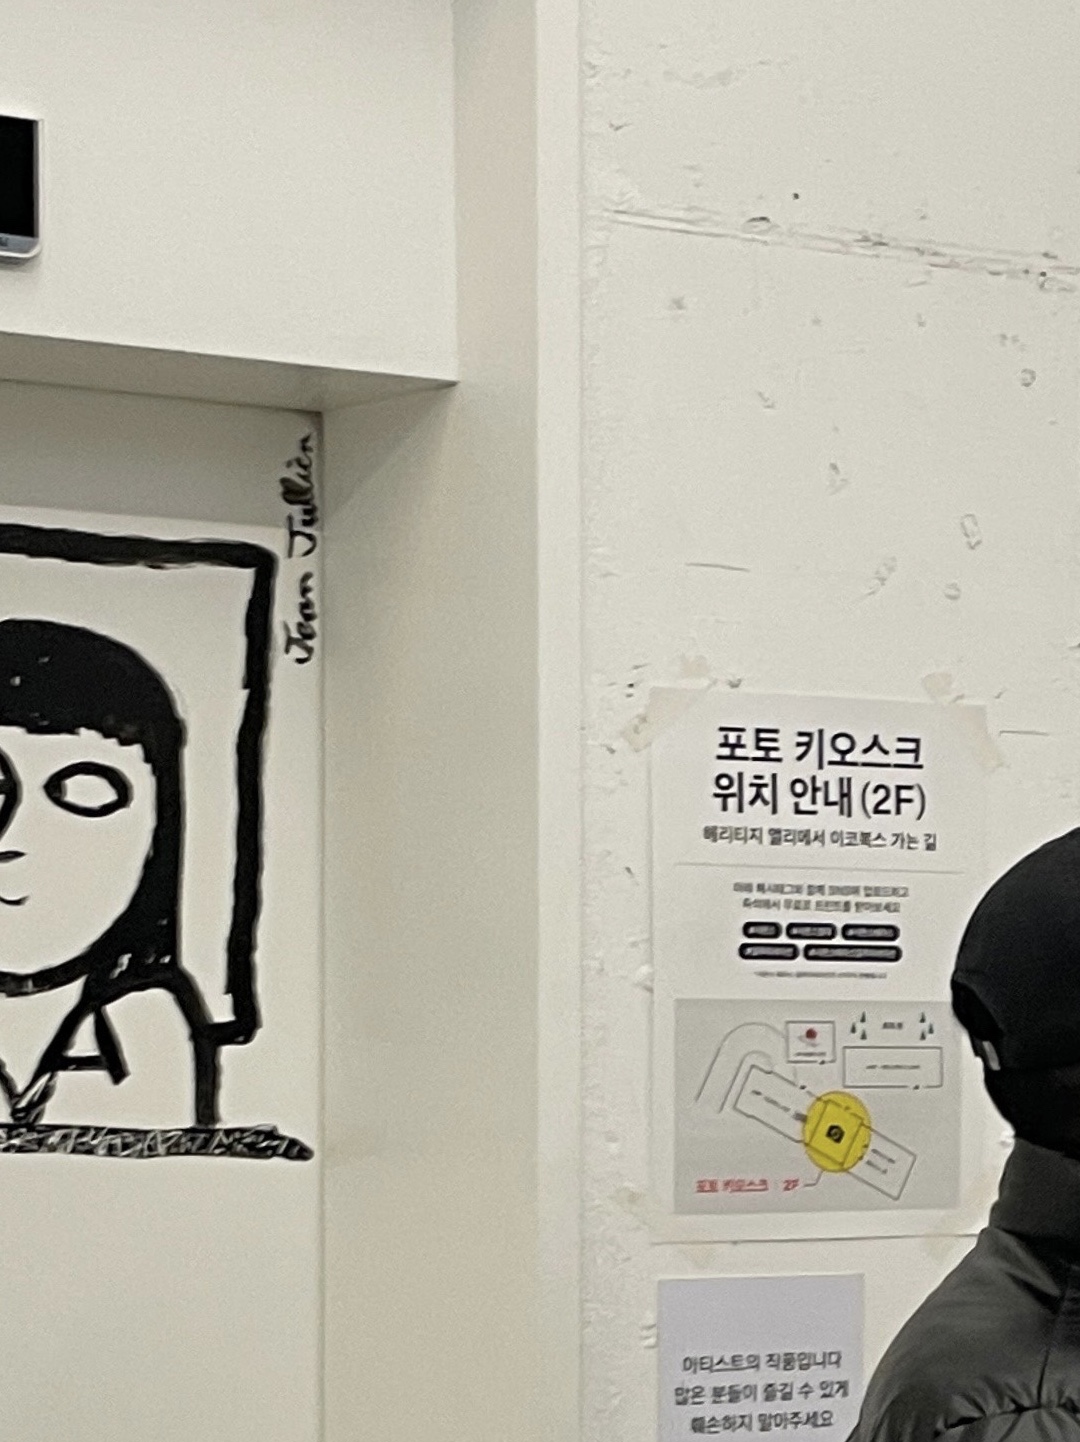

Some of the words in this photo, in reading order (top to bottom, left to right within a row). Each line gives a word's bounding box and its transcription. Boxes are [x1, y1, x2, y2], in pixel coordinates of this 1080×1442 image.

[715, 726, 783, 763] 포토
[795, 728, 924, 770] 키오스크
[712, 771, 778, 815] 위치
[789, 775, 852, 818] 안내
[860, 781, 926, 820] (2F)
[890, 832, 919, 850] 가는
[923, 832, 937, 851] 길
[682, 1353, 760, 1374] 아티스트의
[765, 1351, 842, 1371] 작품입니다
[674, 1384, 706, 1406] 많은
[711, 1383, 757, 1404] 분들이
[763, 1382, 793, 1402] 즐길
[798, 1382, 814, 1400] 수
[819, 1379, 849, 1399] 있게
[690, 1414, 752, 1434] 훼손하지
[758, 1410, 834, 1432] 말아주세요
